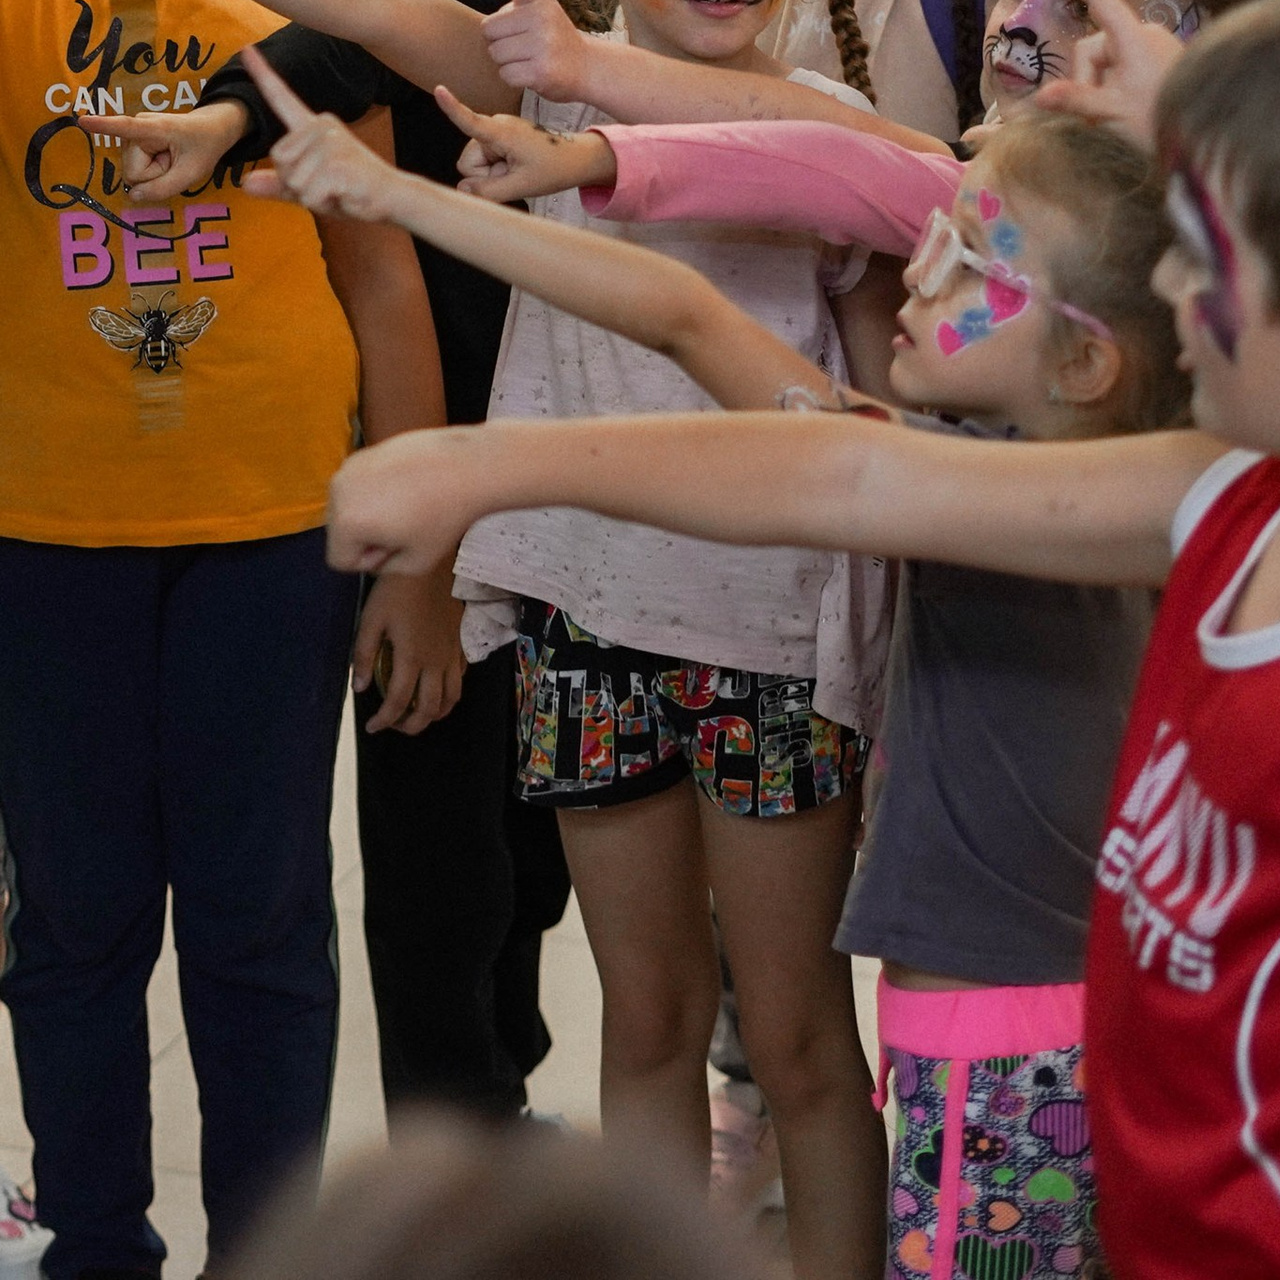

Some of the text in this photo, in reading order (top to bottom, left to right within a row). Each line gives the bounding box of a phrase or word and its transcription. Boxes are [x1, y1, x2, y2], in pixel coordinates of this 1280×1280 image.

[45, 78, 208, 116] CAN CA
[59, 204, 234, 291] BEE
